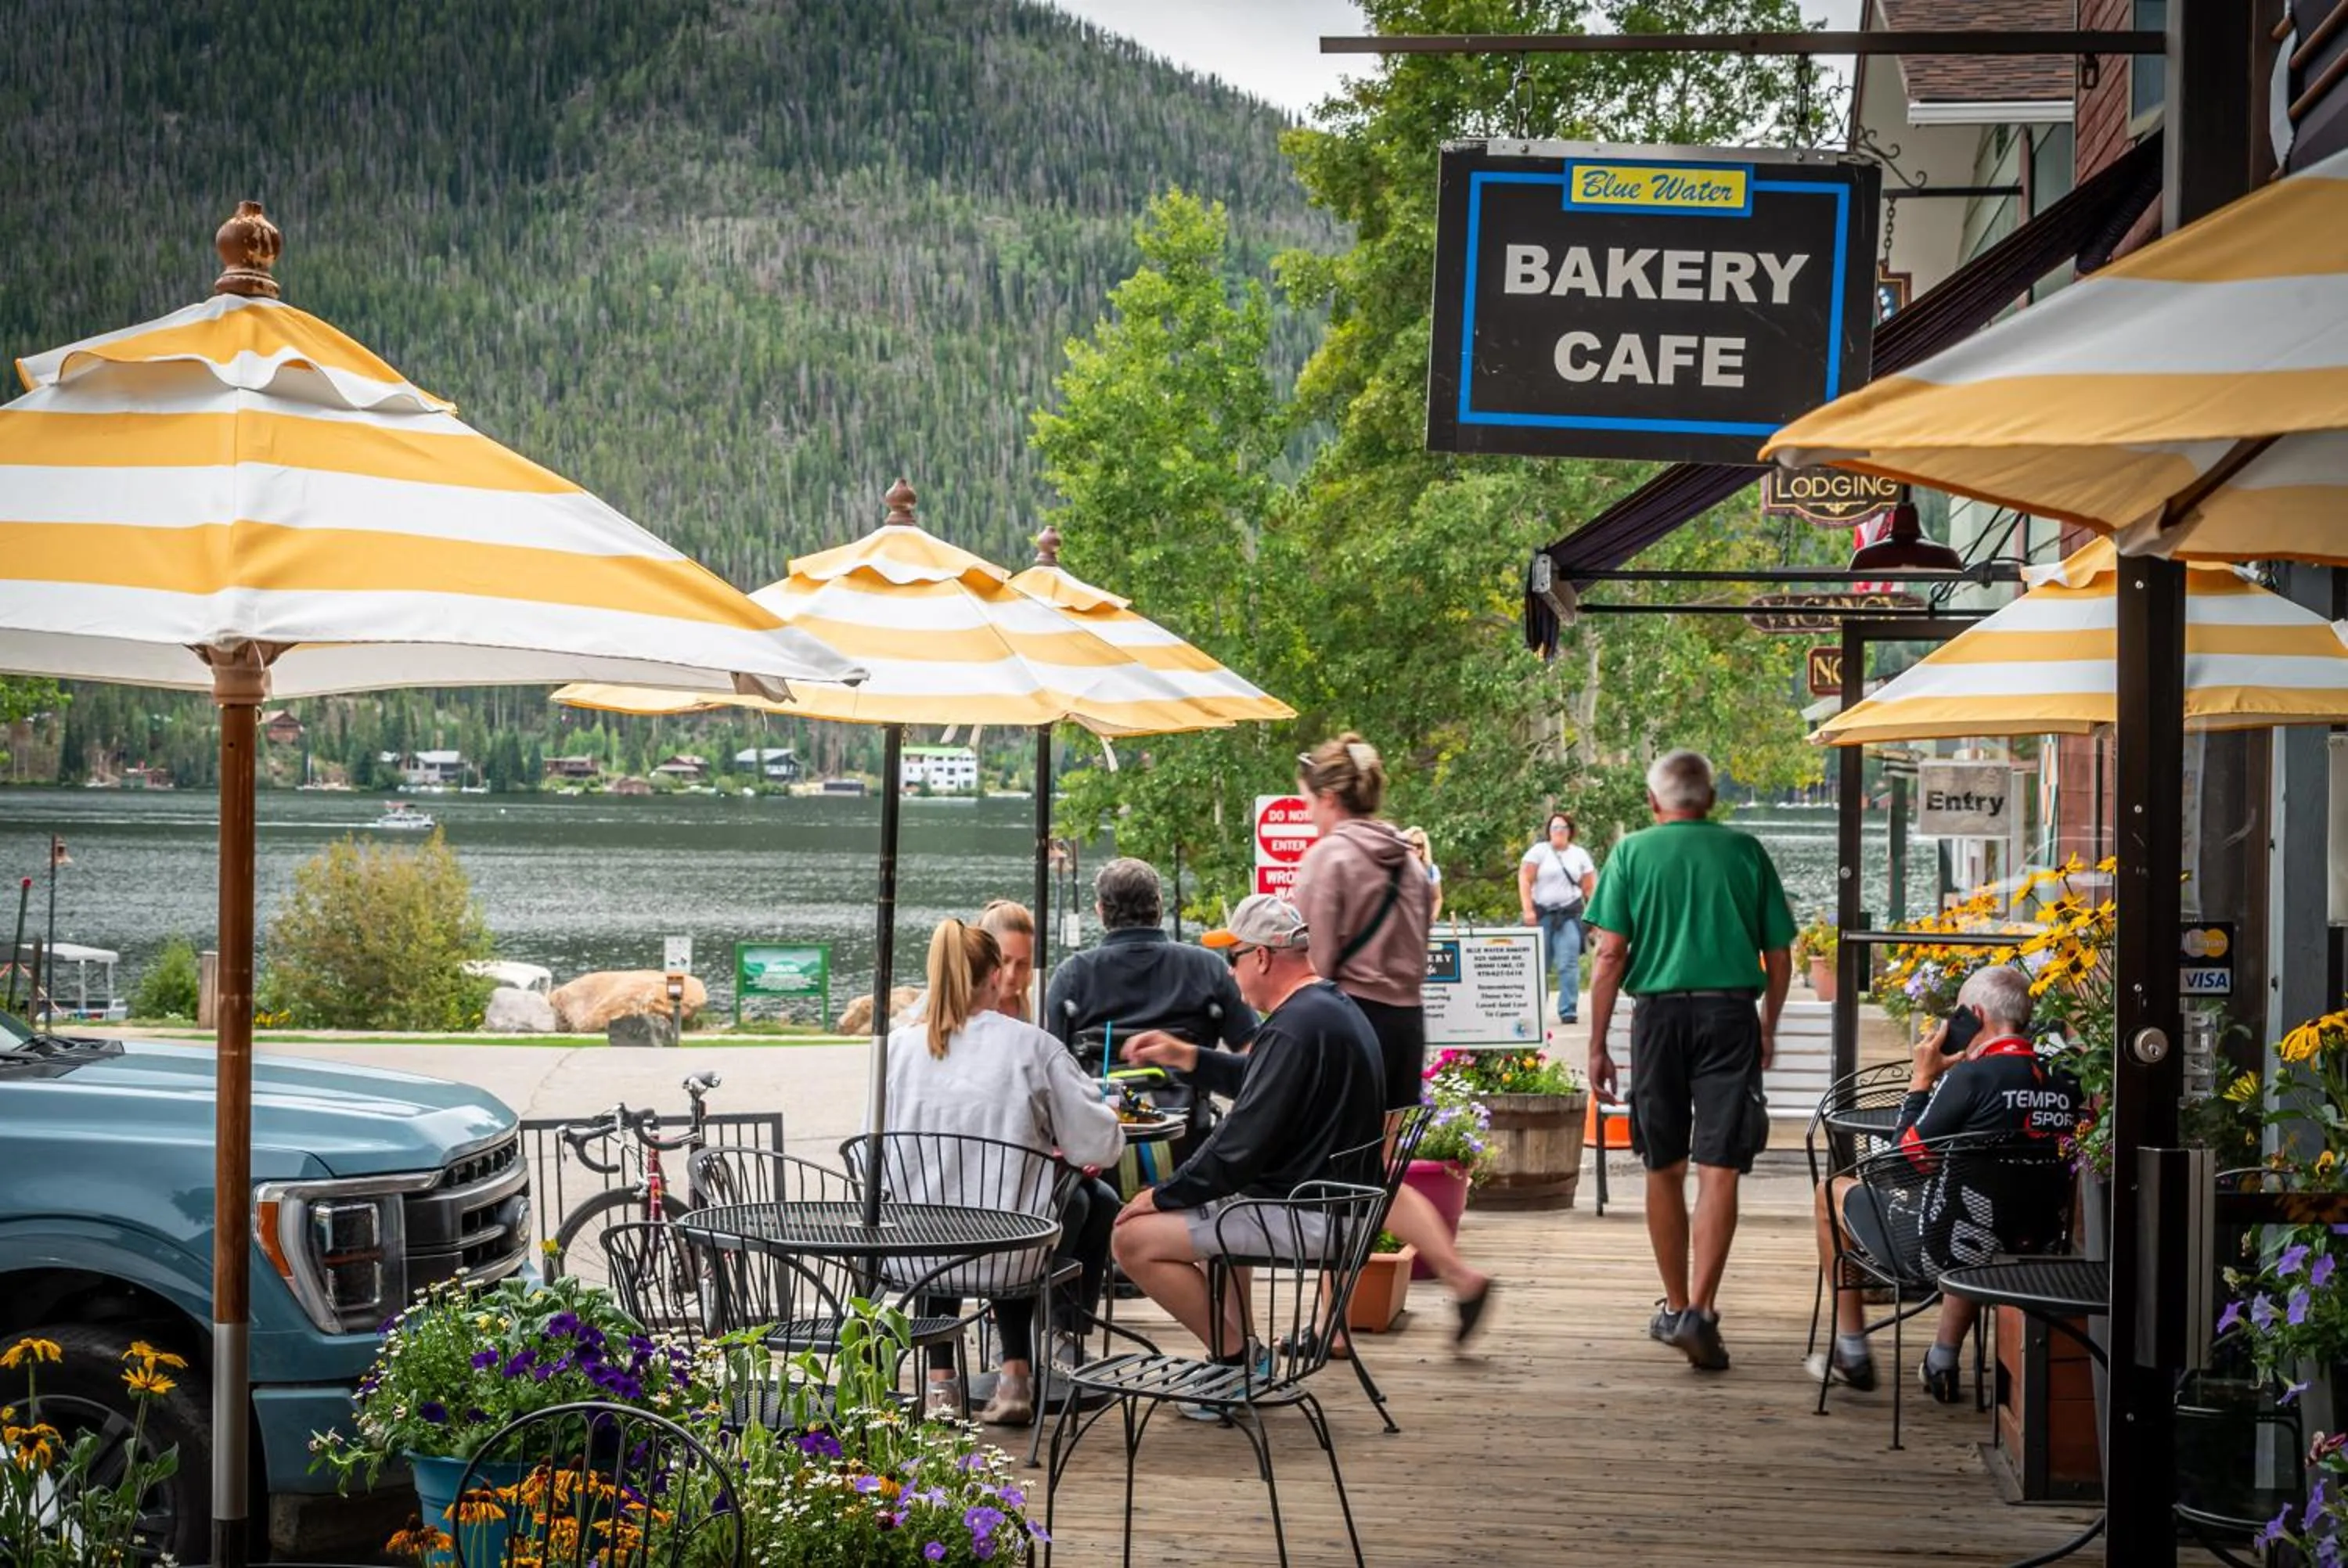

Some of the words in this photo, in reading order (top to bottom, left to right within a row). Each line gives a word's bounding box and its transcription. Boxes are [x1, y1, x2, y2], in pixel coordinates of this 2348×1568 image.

[1582, 169, 1642, 200] Blue
[1651, 174, 1733, 201] Water
[1504, 243, 1810, 304] BAKERY
[1554, 331, 1747, 387] CAFE
[1777, 476, 1898, 498] LODGING
[1926, 789, 2005, 817] Entry
[1268, 810, 1285, 822] DO
[1271, 839, 1308, 851] ENTER
[1266, 870, 1296, 884] WRO
[1275, 886, 1296, 900] WA
[1427, 953, 1453, 962] ERY
[2185, 972, 2228, 988] VISA
[2002, 1089, 2070, 1110] TEMPO
[2031, 1110, 2074, 1127] SPOR
